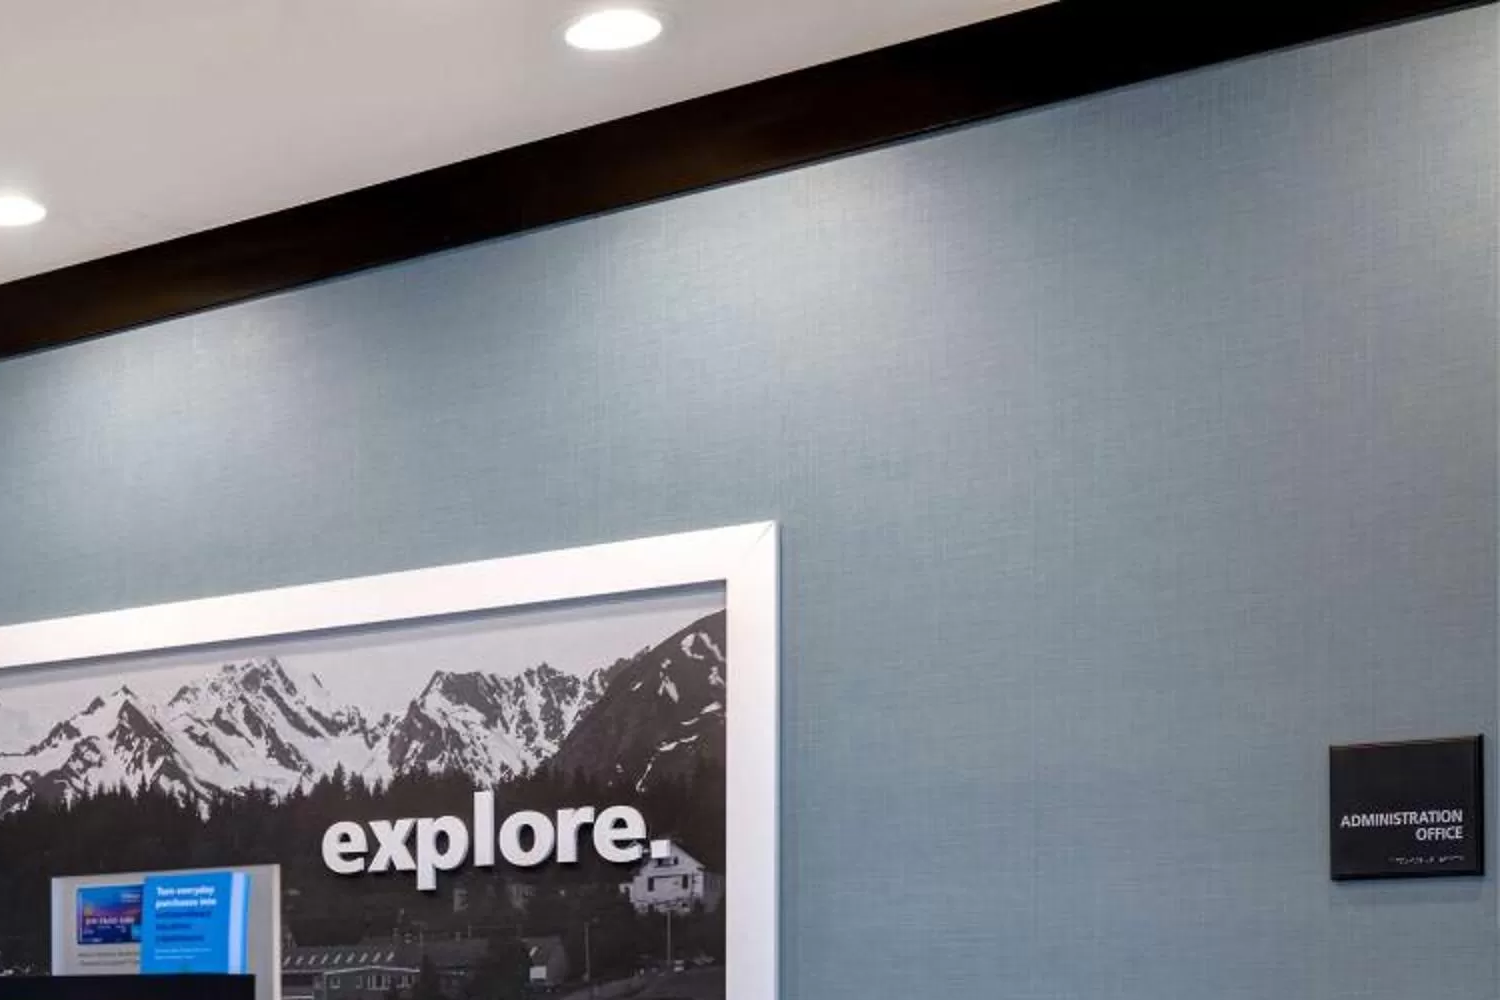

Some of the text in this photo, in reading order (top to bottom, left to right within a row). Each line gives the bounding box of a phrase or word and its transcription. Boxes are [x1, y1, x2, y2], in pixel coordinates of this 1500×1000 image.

[1340, 809, 1463, 828] ADMINISTRATION
[321, 790, 672, 891] explore.
[1415, 825, 1463, 841] OFFICE
